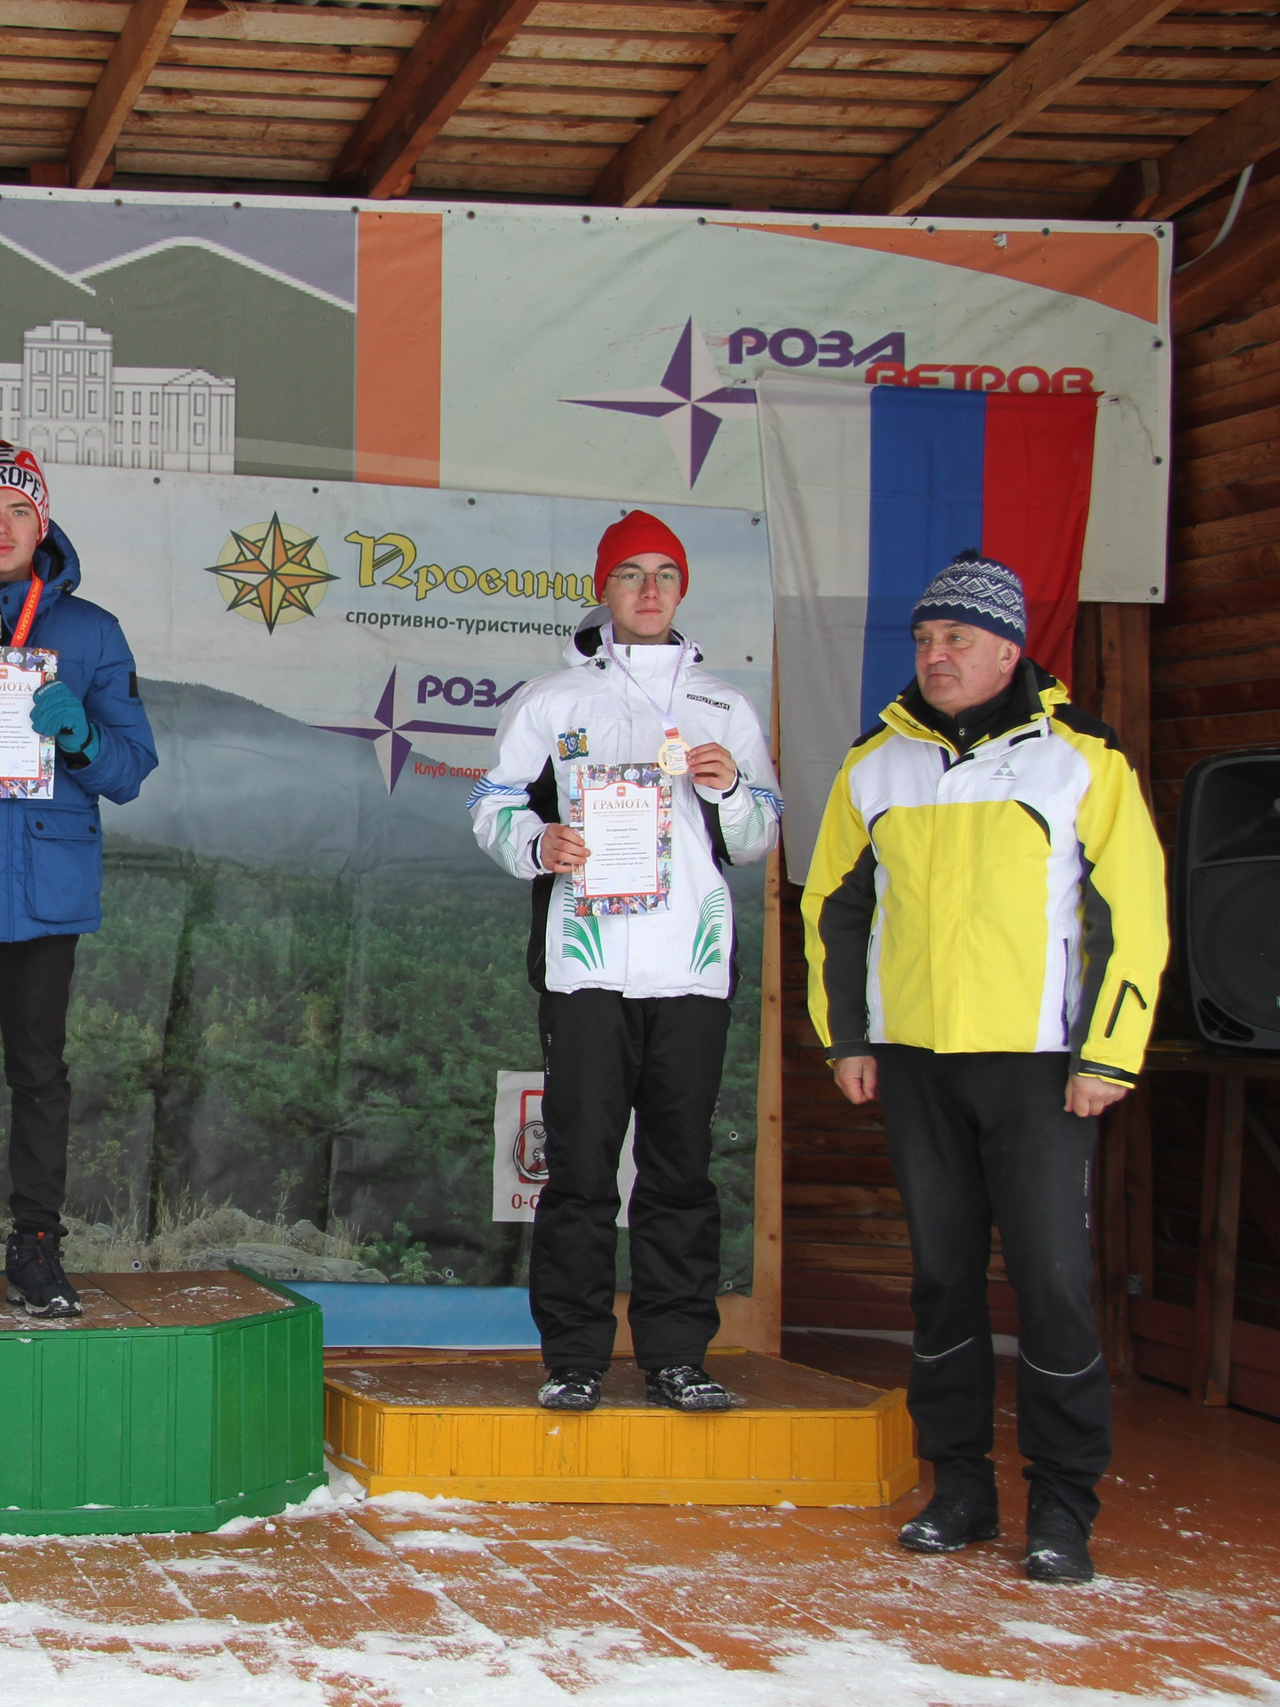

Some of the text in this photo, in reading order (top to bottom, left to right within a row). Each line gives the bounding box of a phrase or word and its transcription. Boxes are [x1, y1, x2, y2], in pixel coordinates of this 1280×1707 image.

[728, 327, 906, 367] РОЗА
[344, 530, 601, 608] Провинц
[345, 610, 577, 637] спортивно-туристическ
[414, 761, 446, 779] Клуб
[593, 799, 650, 810] ГРАМОТА
